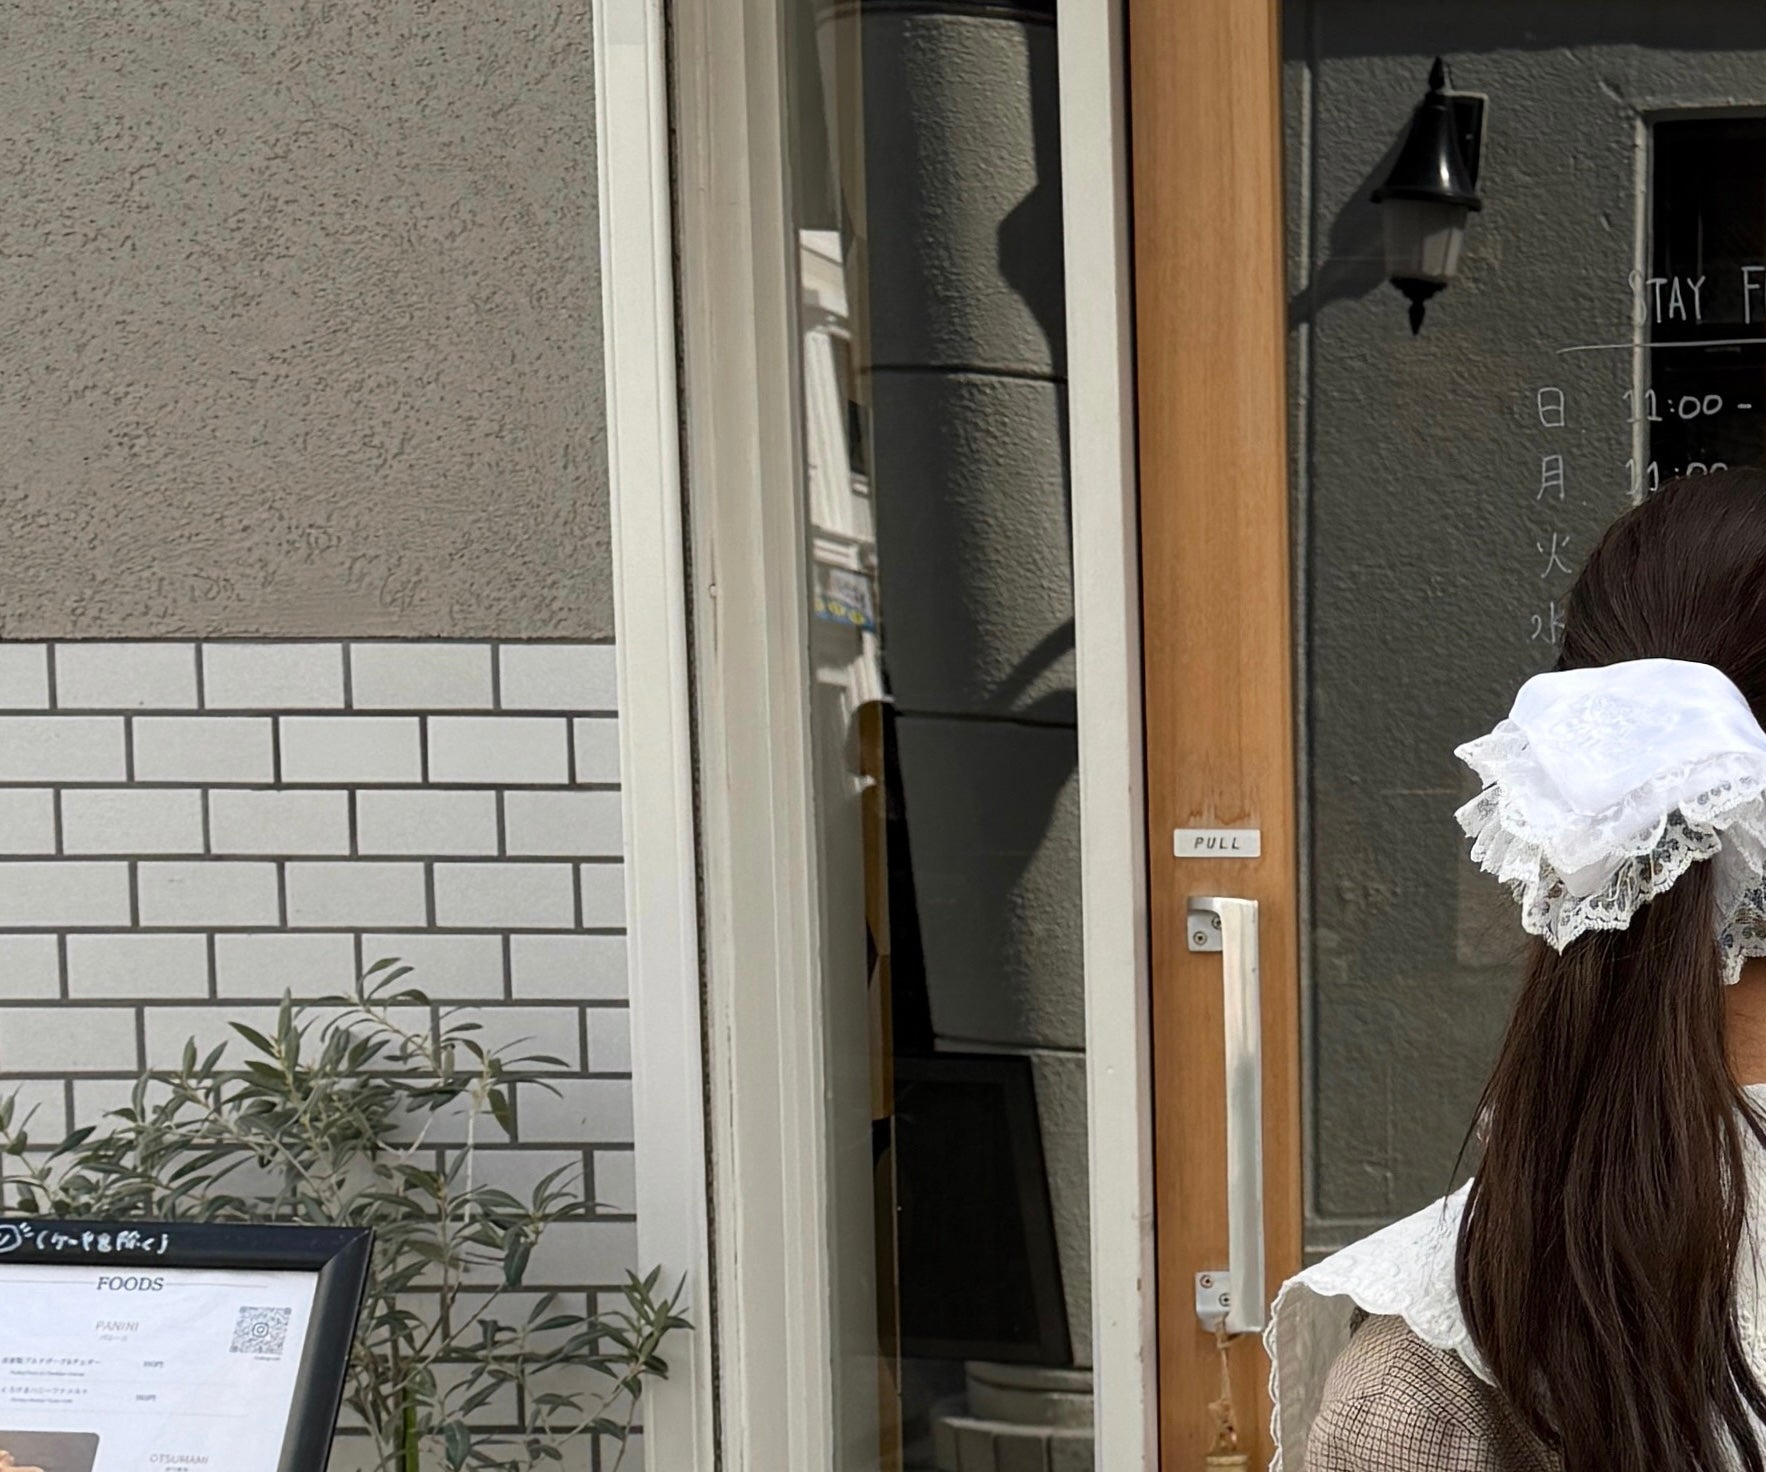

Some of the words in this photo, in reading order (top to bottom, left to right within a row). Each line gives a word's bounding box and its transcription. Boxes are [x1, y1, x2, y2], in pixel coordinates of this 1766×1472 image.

[1628, 269, 1706, 327] STAY
[1537, 387, 1565, 427] 日
[1622, 388, 1723, 422] 11:00
[1537, 454, 1565, 500] 月
[1536, 532, 1573, 578] 火
[1193, 836, 1241, 850] PULL
[96, 1276, 165, 1292] FOODS
[95, 1319, 140, 1332] PANINI
